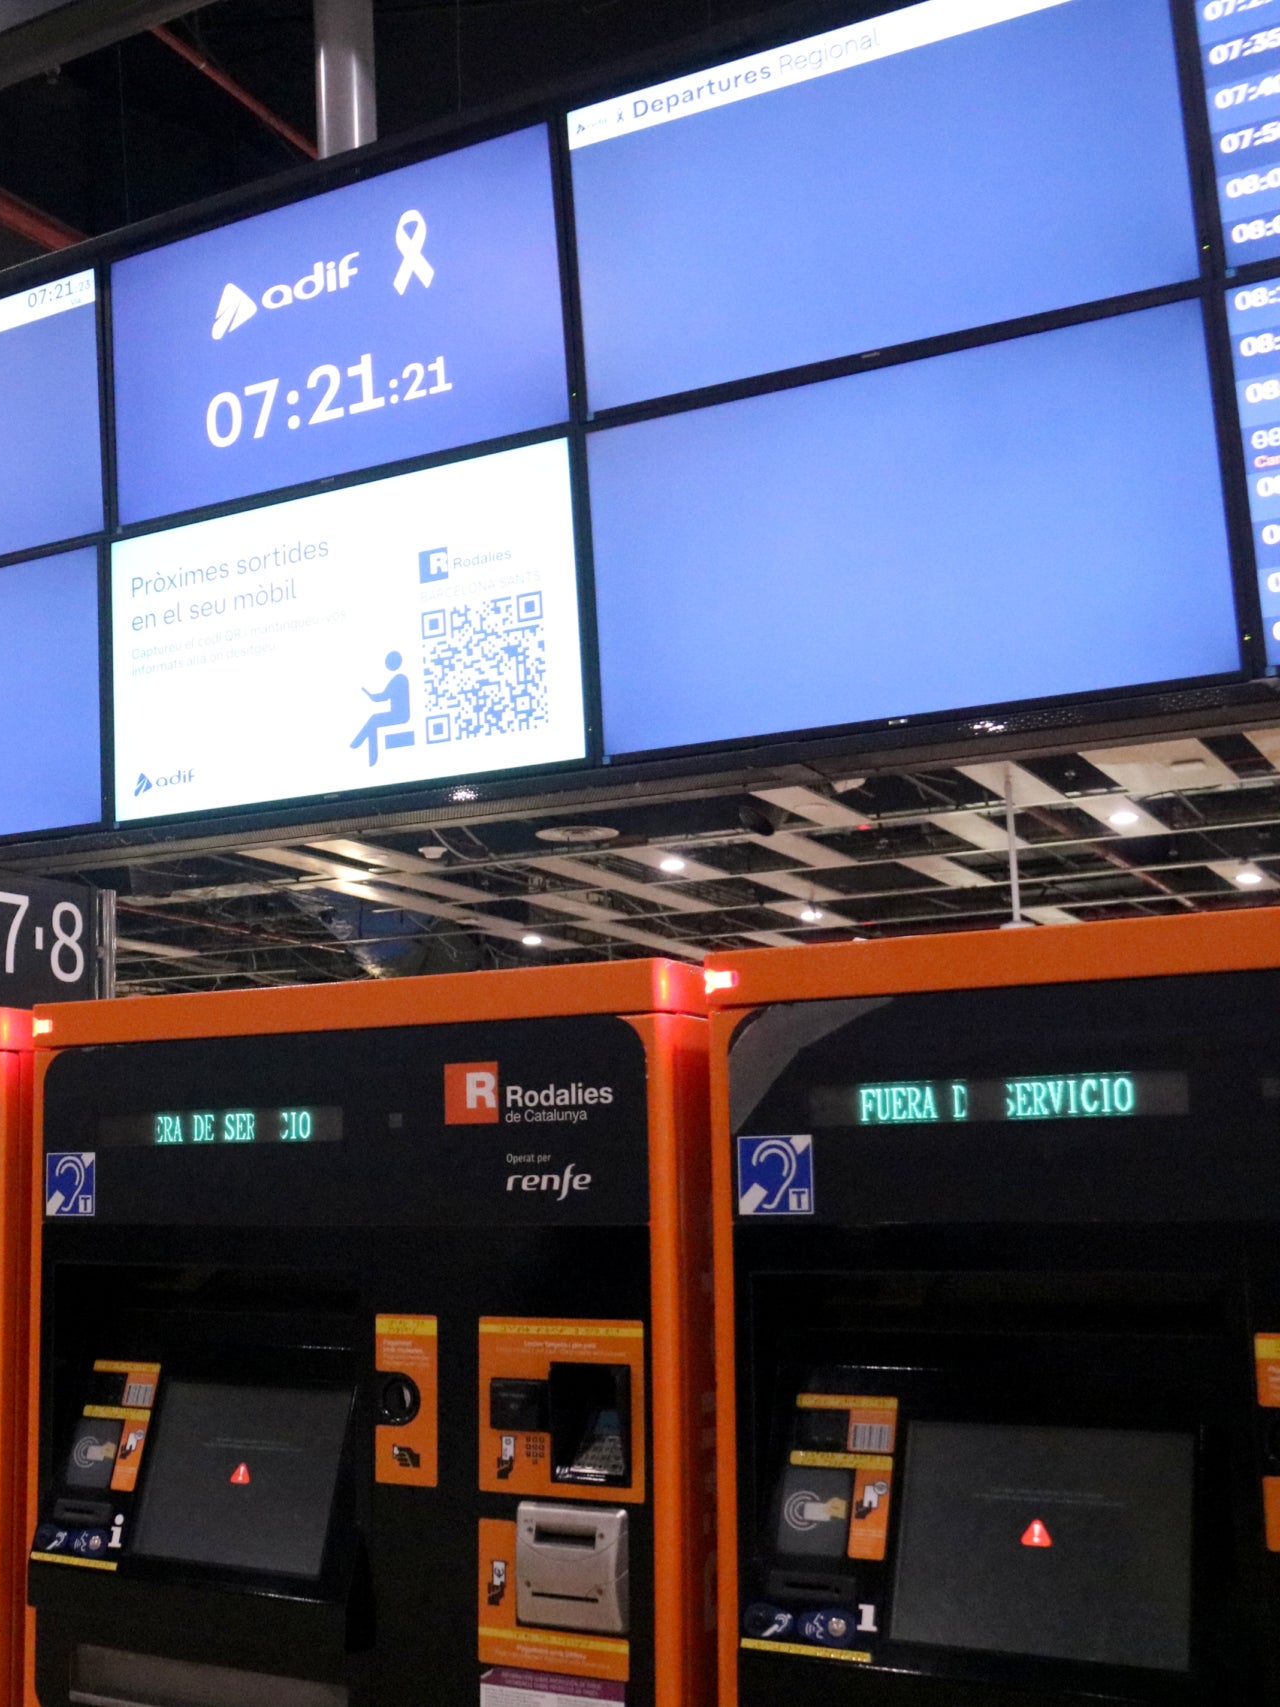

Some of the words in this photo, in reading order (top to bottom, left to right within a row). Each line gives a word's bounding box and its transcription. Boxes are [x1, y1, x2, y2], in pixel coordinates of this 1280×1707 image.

[633, 64, 771, 118] Departures
[779, 27, 880, 75] Regional
[261, 251, 360, 310] adif
[205, 353, 453, 449] 07:21:21
[131, 562, 229, 598] Pròximes
[236, 540, 329, 575] sortides
[453, 549, 512, 570] Rodalies
[131, 612, 156, 632] en
[163, 602, 182, 625] el
[189, 598, 226, 620] seu
[233, 577, 297, 611] mòbil
[155, 768, 196, 788] adif
[506, 1082, 614, 1108] Rodalies
[860, 1086, 939, 1122] FUERA
[1006, 1077, 1134, 1117] SERVICIO
[505, 1111, 520, 1123] de
[524, 1108, 587, 1124] Catalunya
[506, 1153, 534, 1165] Operat
[537, 1154, 551, 1164] per
[505, 1163, 592, 1201] renfe
